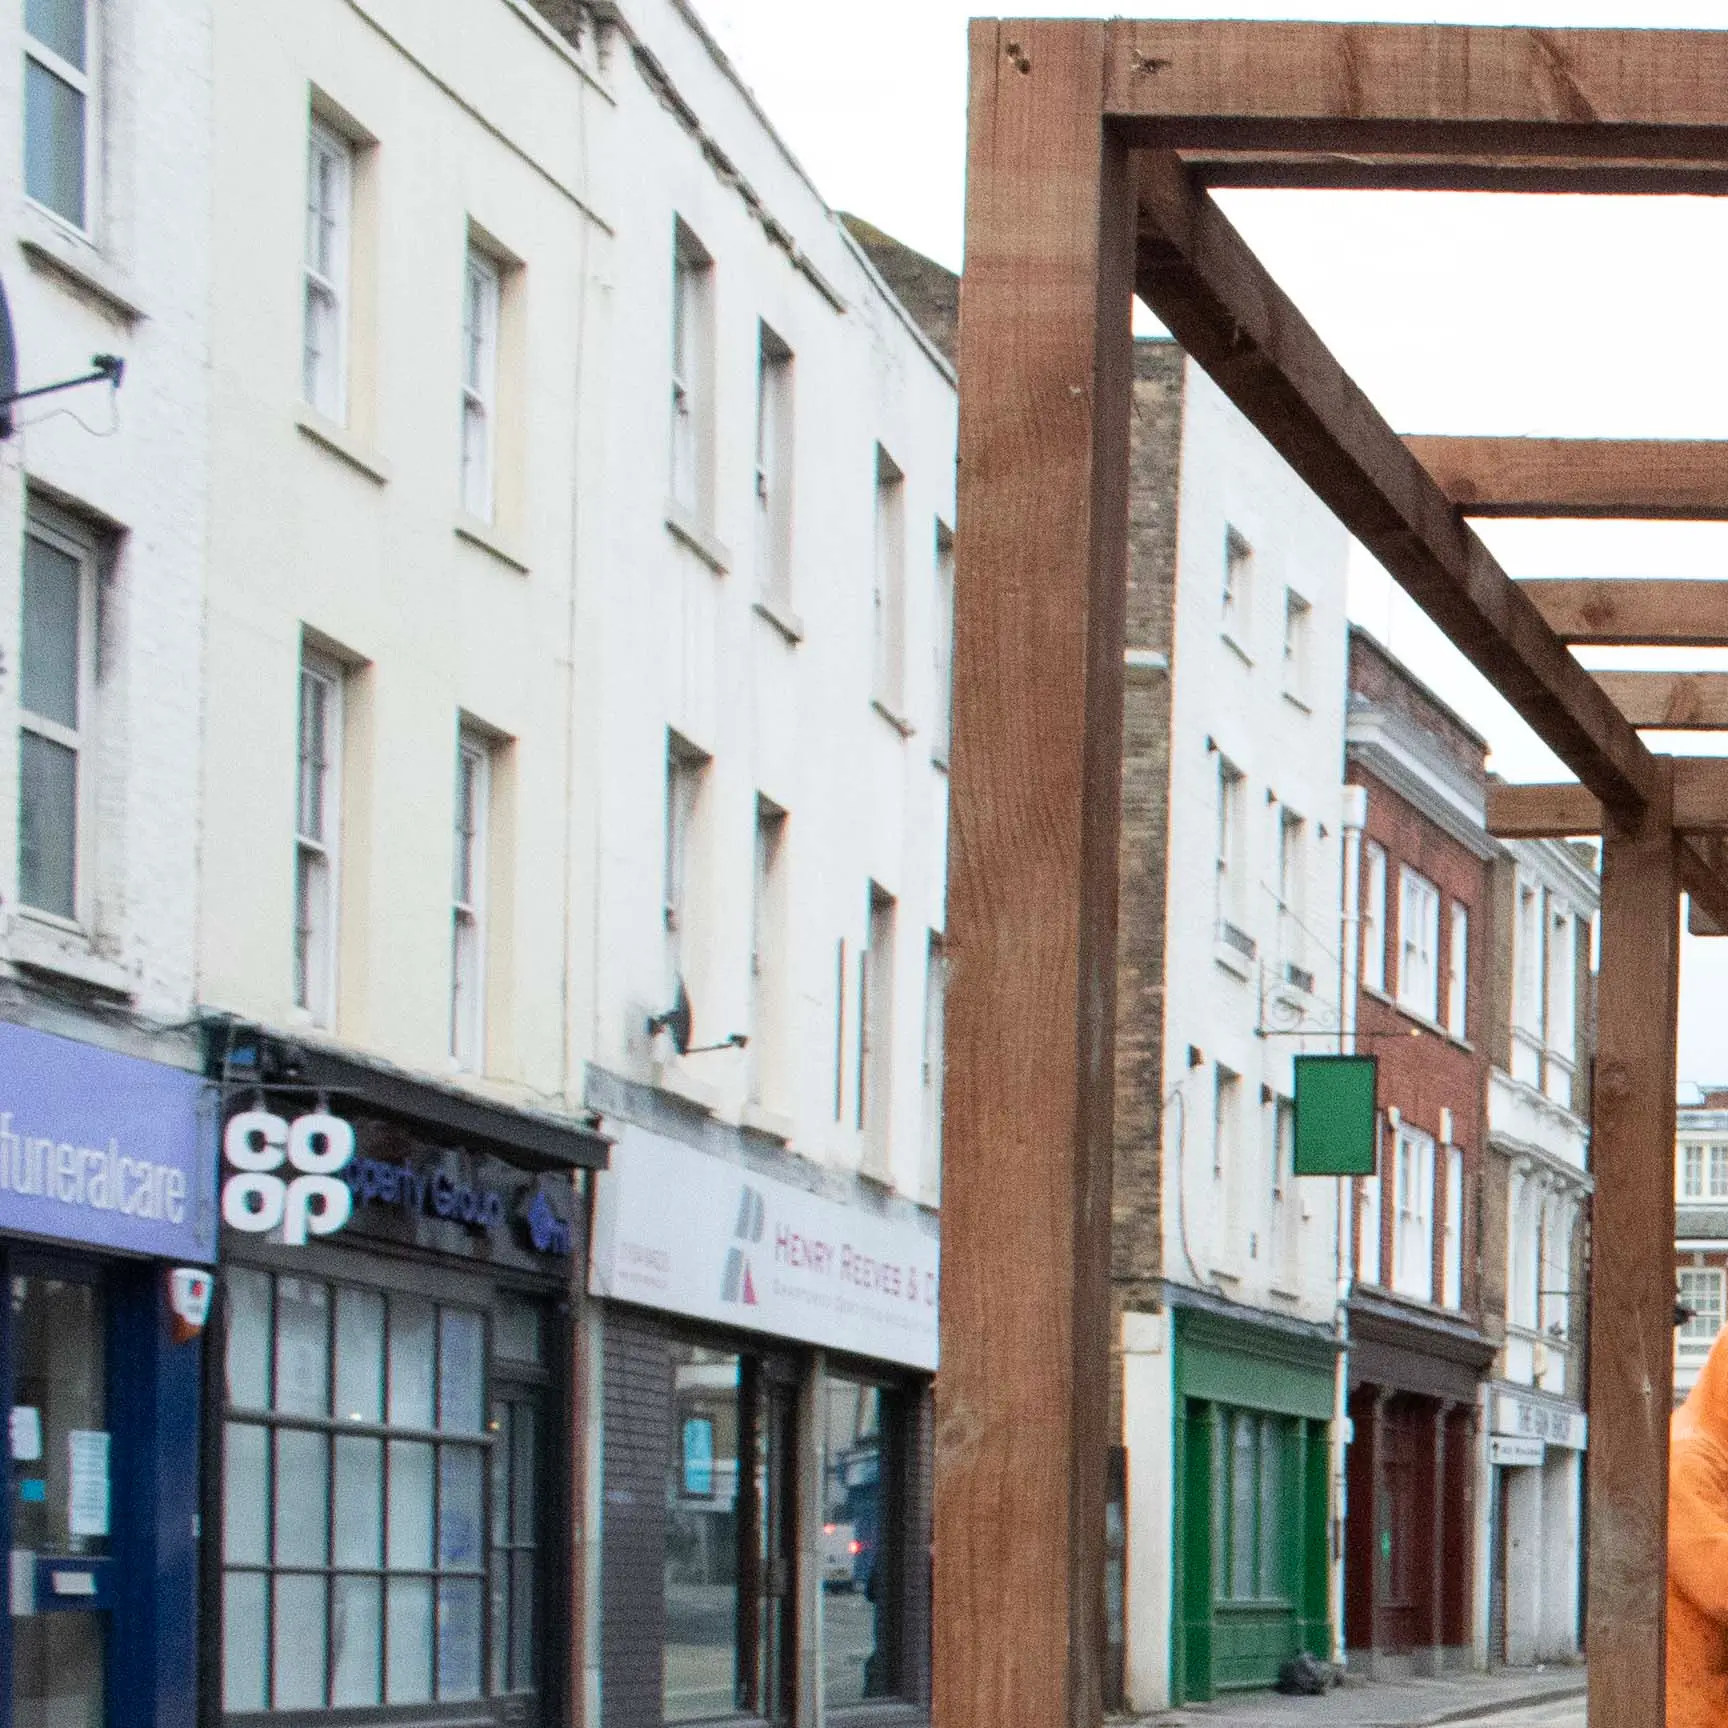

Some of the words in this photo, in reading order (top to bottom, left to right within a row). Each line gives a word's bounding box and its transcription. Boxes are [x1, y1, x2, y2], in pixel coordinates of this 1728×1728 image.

[0, 1112, 188, 1225] funeralcare
[775, 1222, 833, 1275] HENRY
[841, 1243, 902, 1298] REEVES
